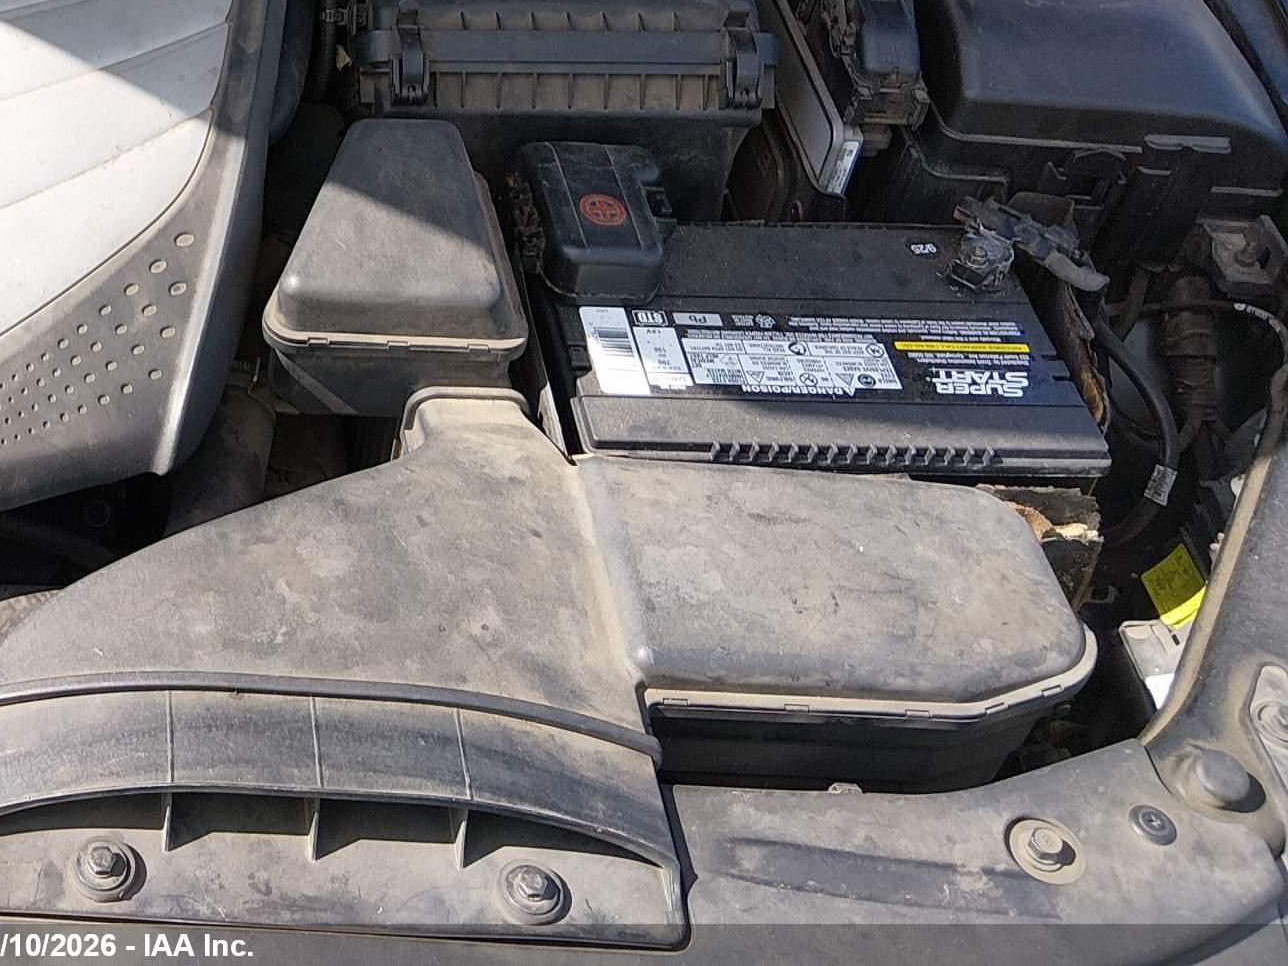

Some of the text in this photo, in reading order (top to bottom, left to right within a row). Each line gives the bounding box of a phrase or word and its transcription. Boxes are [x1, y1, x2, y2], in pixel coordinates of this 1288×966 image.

[638, 313, 663, 323] STD
[688, 315, 707, 323] Pb
[932, 369, 1029, 387] START
[742, 384, 845, 395] DANGER/POISON
[935, 382, 1024, 397] SUPER
